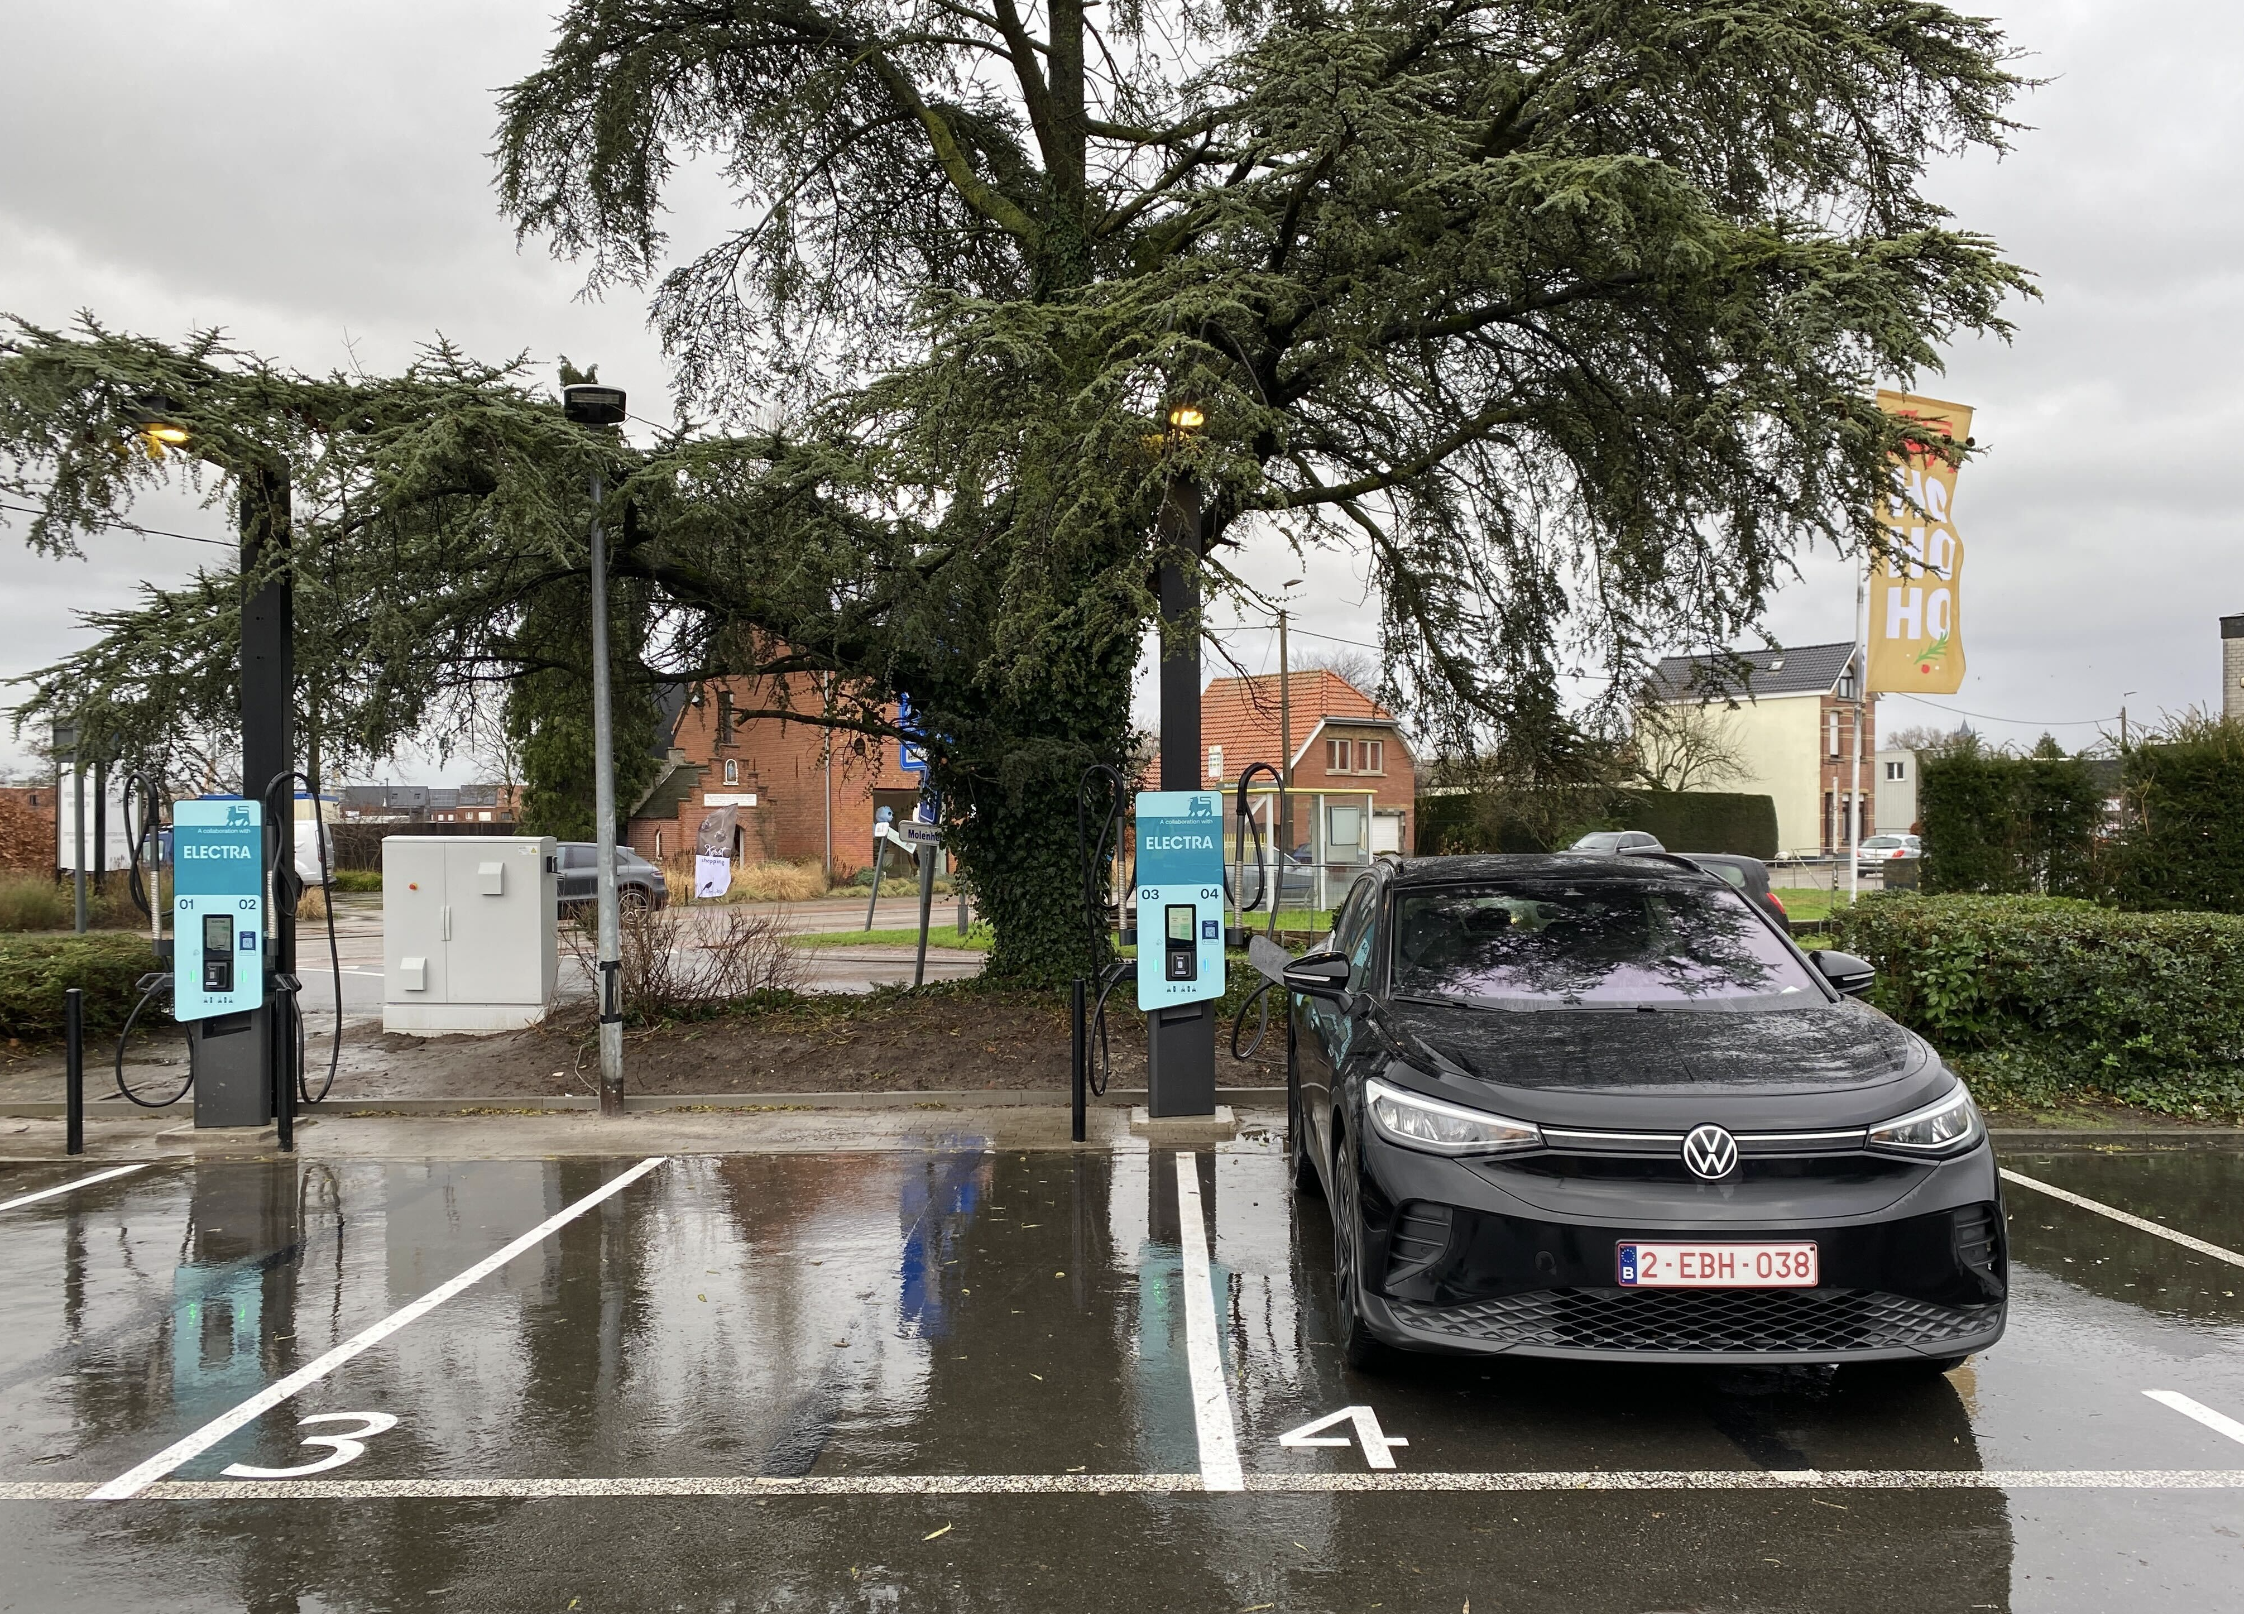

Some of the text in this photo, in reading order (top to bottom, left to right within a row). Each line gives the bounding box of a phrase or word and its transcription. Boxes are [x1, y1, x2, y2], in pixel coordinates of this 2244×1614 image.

[1889, 467, 1948, 523] HO
[1888, 526, 1956, 581] HO
[1886, 586, 1951, 641] HO
[183, 845, 252, 859] ELECTRA
[1146, 835, 1214, 850] ELECTRA
[179, 899, 194, 910] 01
[238, 899, 257, 910] 02
[1141, 889, 1160, 900] 03
[1200, 888, 1219, 900] 04
[1684, 1126, 1738, 1179] VW
[1622, 1251, 1810, 1280] B 2-EBH-038
[219, 1411, 398, 1478] 3
[1278, 1405, 1409, 1469] 4
